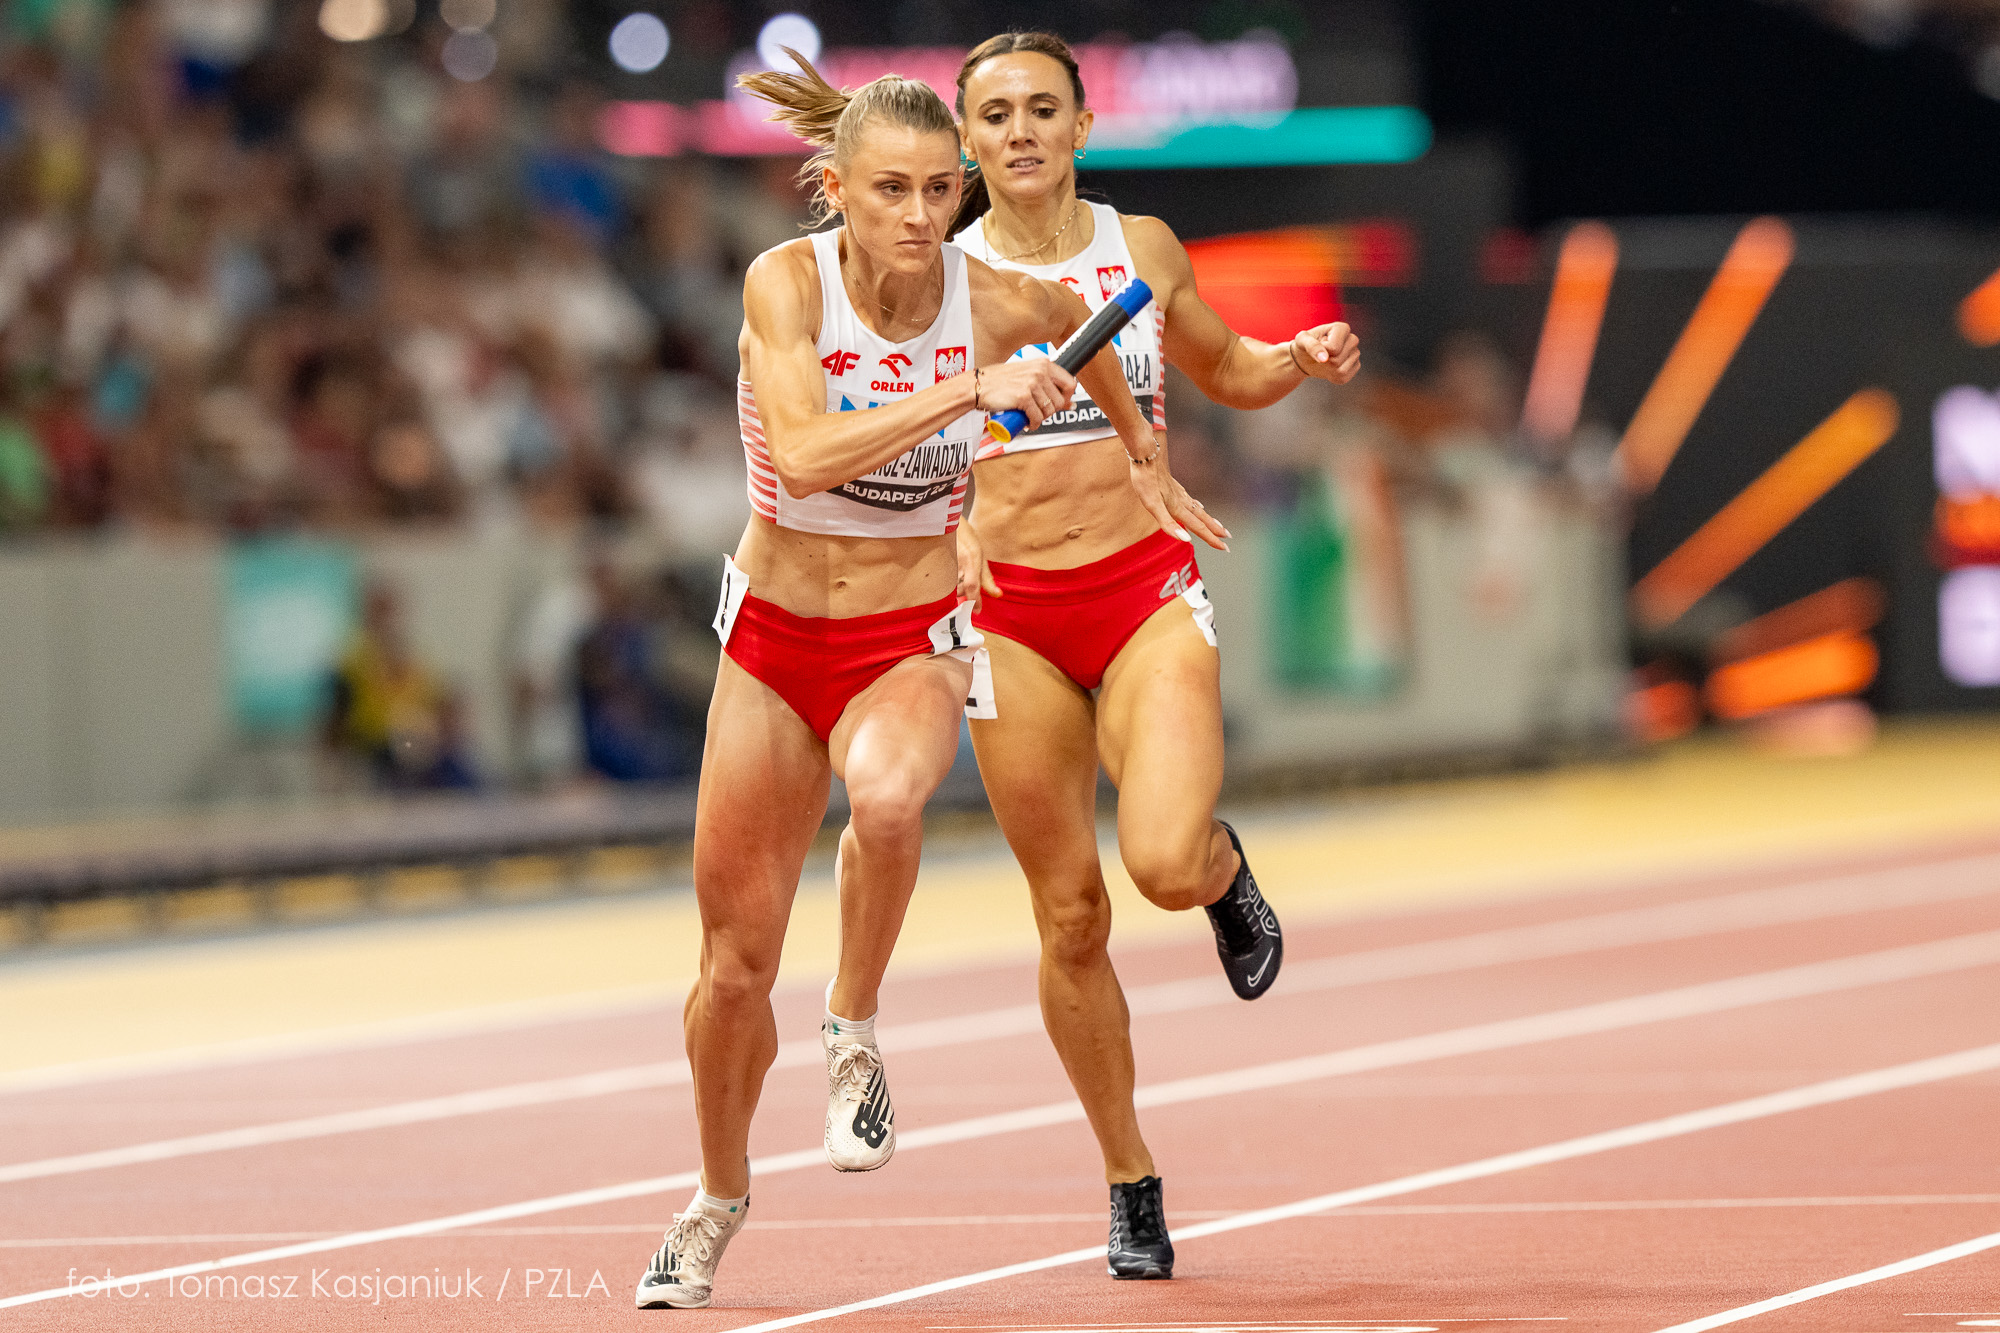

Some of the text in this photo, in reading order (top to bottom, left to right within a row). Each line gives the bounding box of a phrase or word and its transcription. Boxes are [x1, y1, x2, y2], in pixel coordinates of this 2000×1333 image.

[821, 349, 861, 377] 4F
[1118, 353, 1151, 389] AŁA
[870, 380, 914, 393] ORLEN
[842, 482, 931, 505] BUDAPEST
